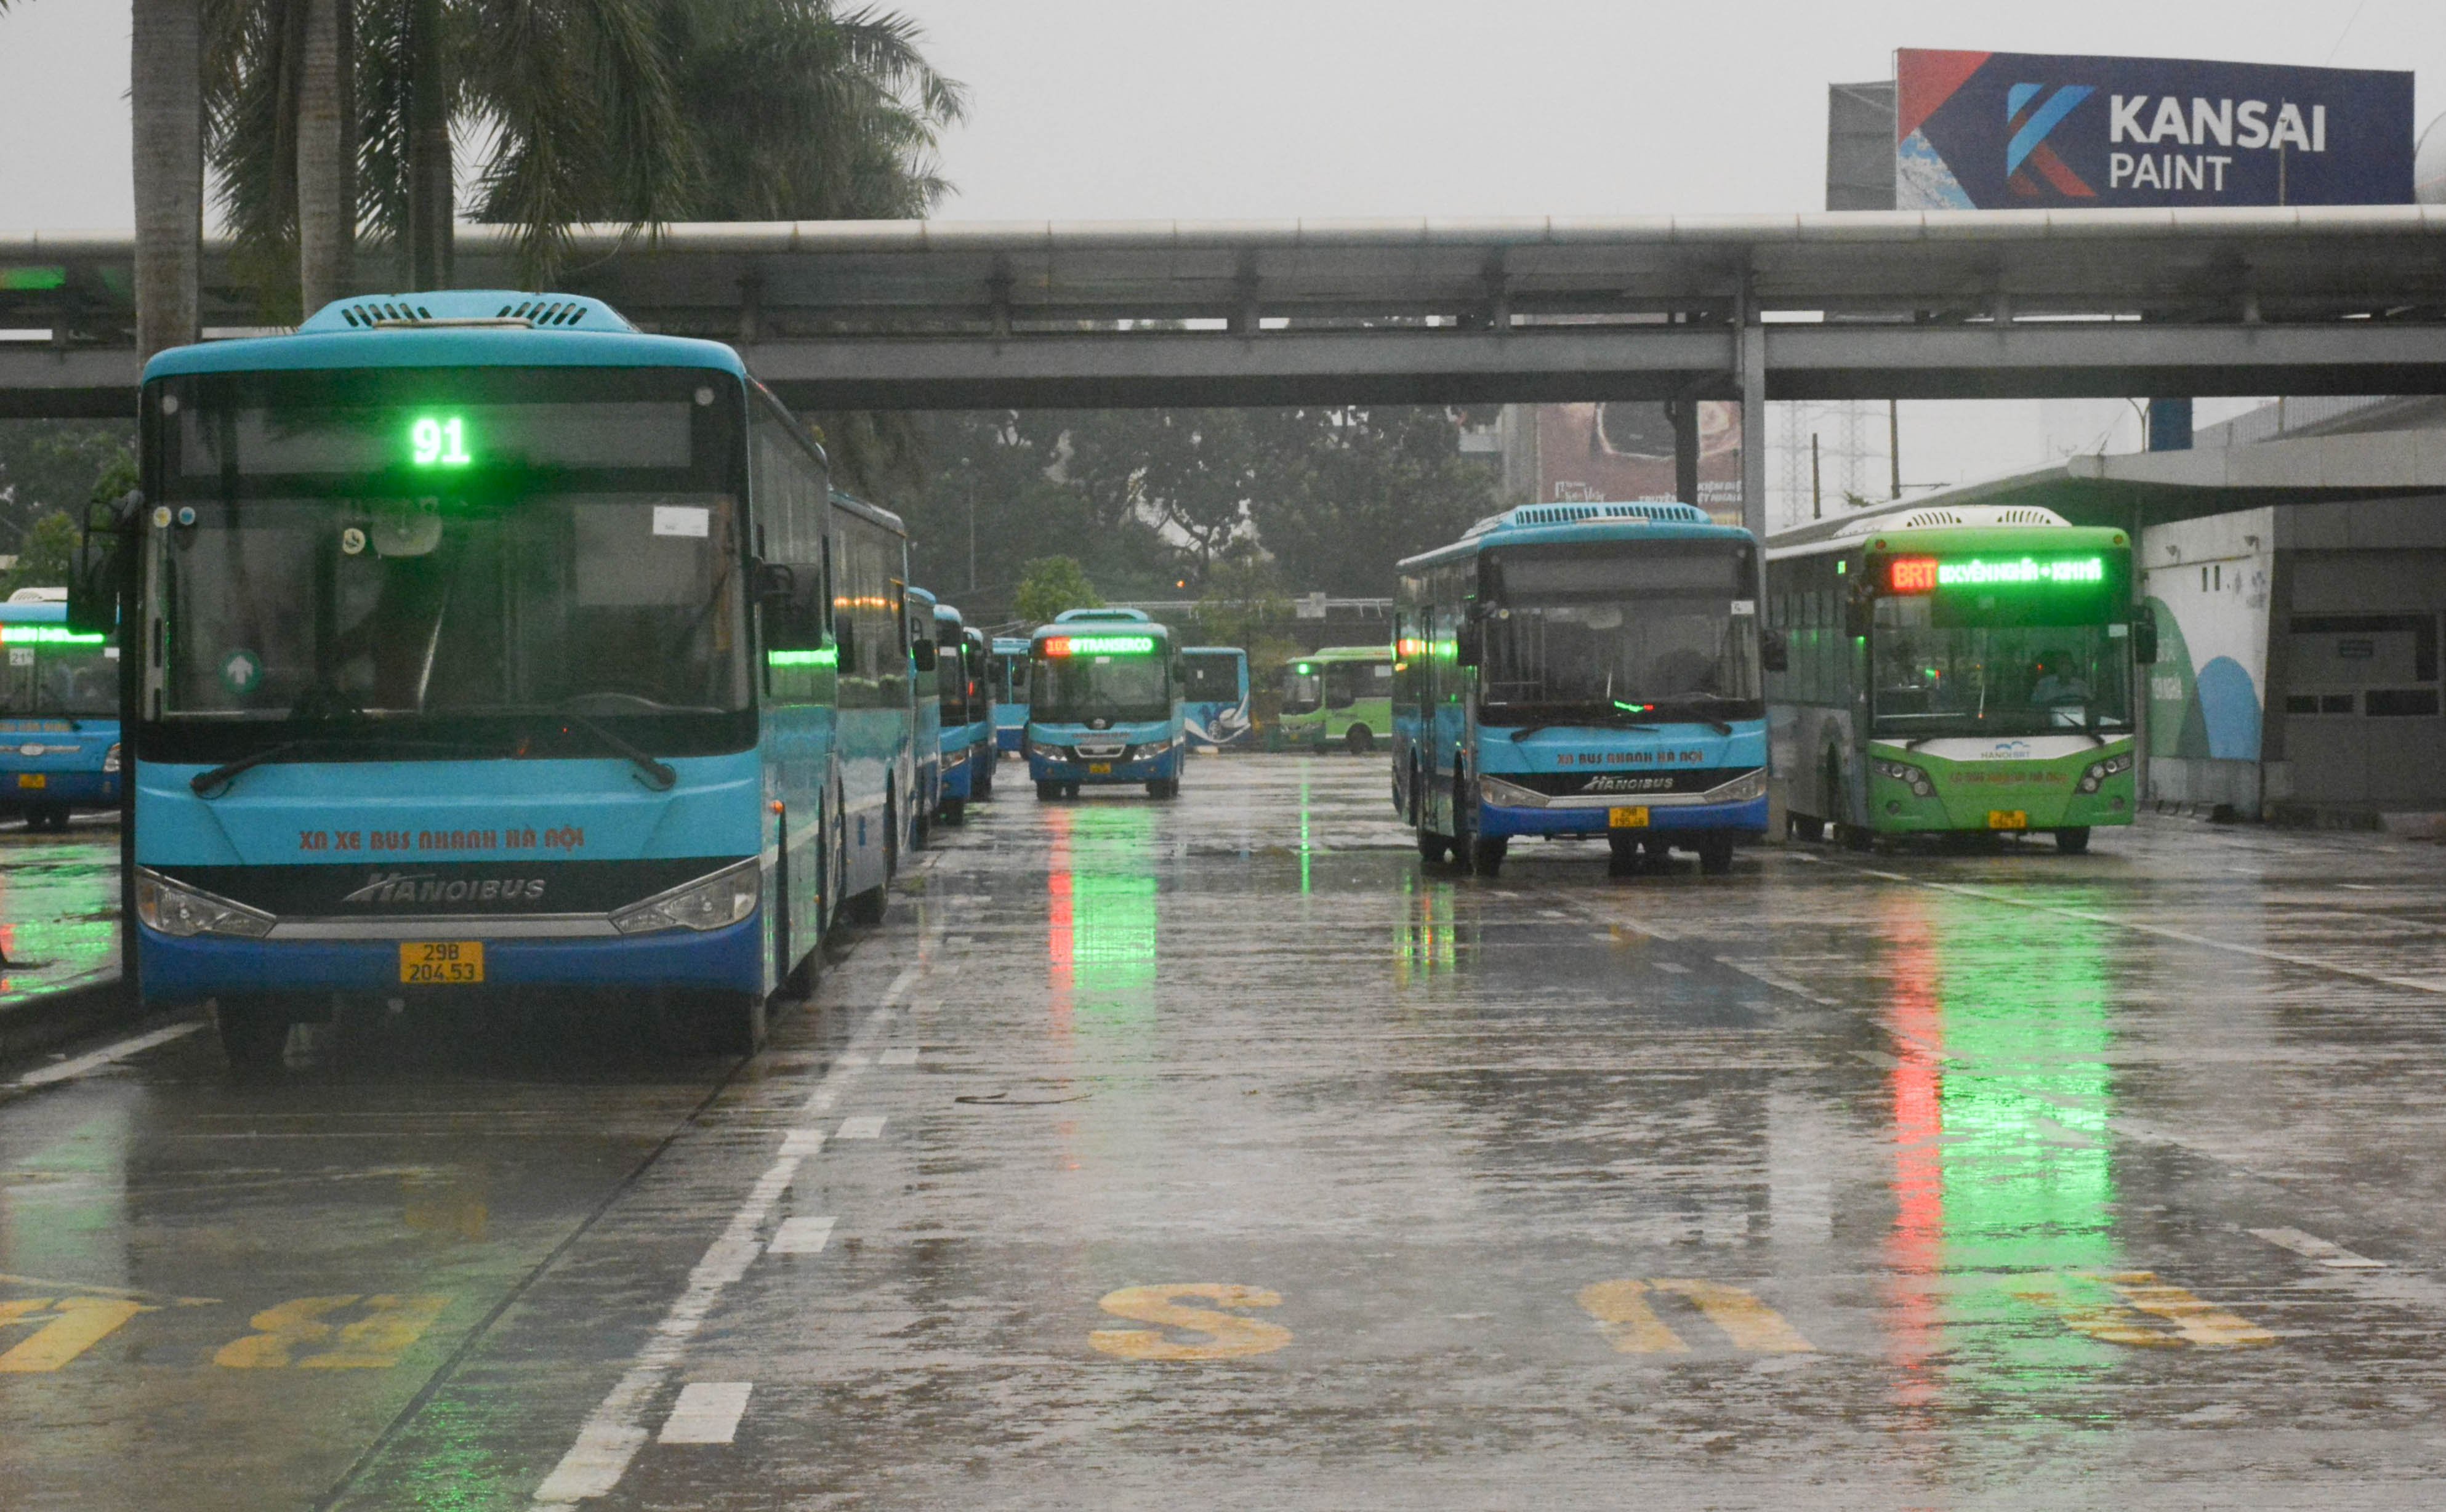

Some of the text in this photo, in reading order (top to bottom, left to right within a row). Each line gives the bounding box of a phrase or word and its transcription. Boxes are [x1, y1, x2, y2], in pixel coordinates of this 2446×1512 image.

[2109, 94, 2325, 152] KANSAI
[2109, 153, 2231, 191] PAINT
[413, 416, 471, 465] 91
[1894, 563, 1936, 588] BRT
[334, 831, 361, 851] XE
[371, 830, 411, 851] BUS
[418, 829, 497, 850] NHANH
[505, 824, 537, 849] HÀ
[544, 824, 584, 852] NỘI
[424, 944, 460, 962] 29B
[409, 963, 475, 982] 204.53
